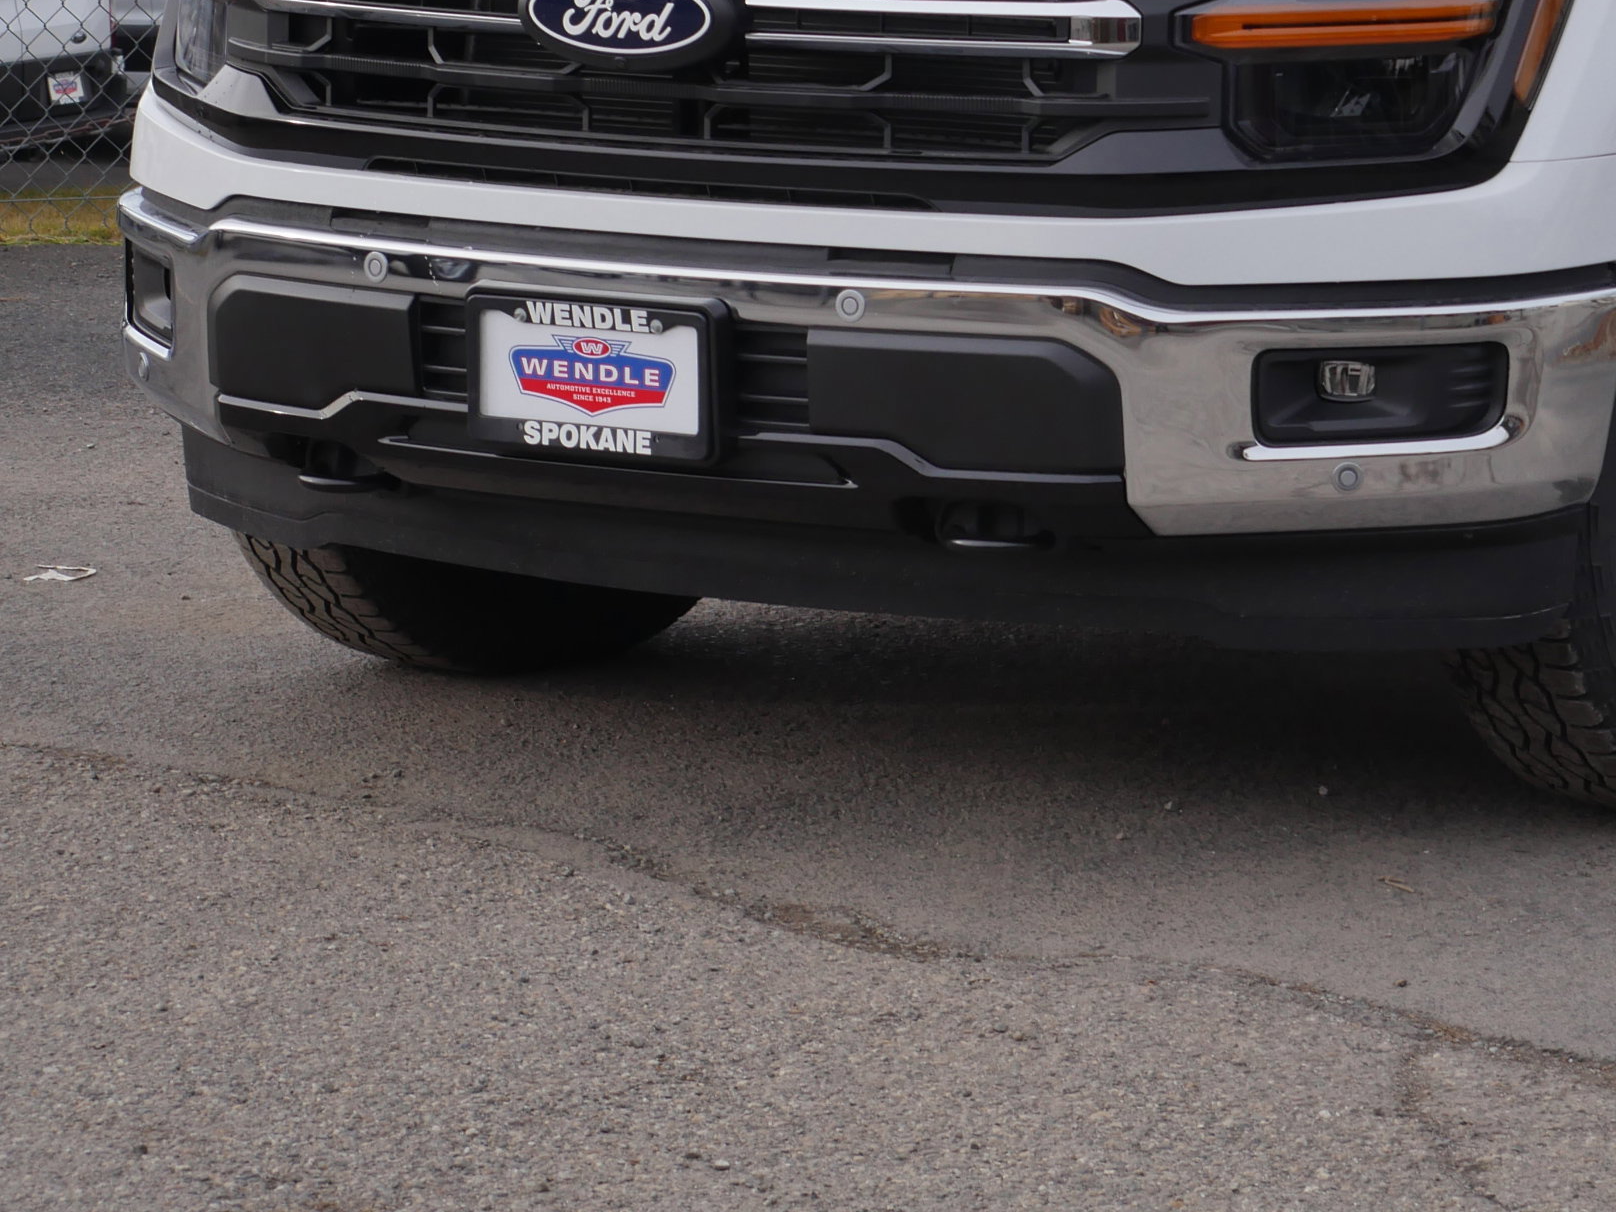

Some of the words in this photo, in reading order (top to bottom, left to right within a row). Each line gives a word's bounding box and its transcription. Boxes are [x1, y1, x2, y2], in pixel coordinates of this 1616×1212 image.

[526, 300, 650, 333] WENDLE
[580, 342, 604, 355] W
[521, 357, 660, 387] WENDLE
[546, 383, 591, 394] AUTOMOTIVE
[592, 387, 636, 398] EXCELLENCE
[573, 393, 594, 402] SINCE
[595, 395, 612, 403] 1943
[523, 420, 652, 455] SPOKANE
